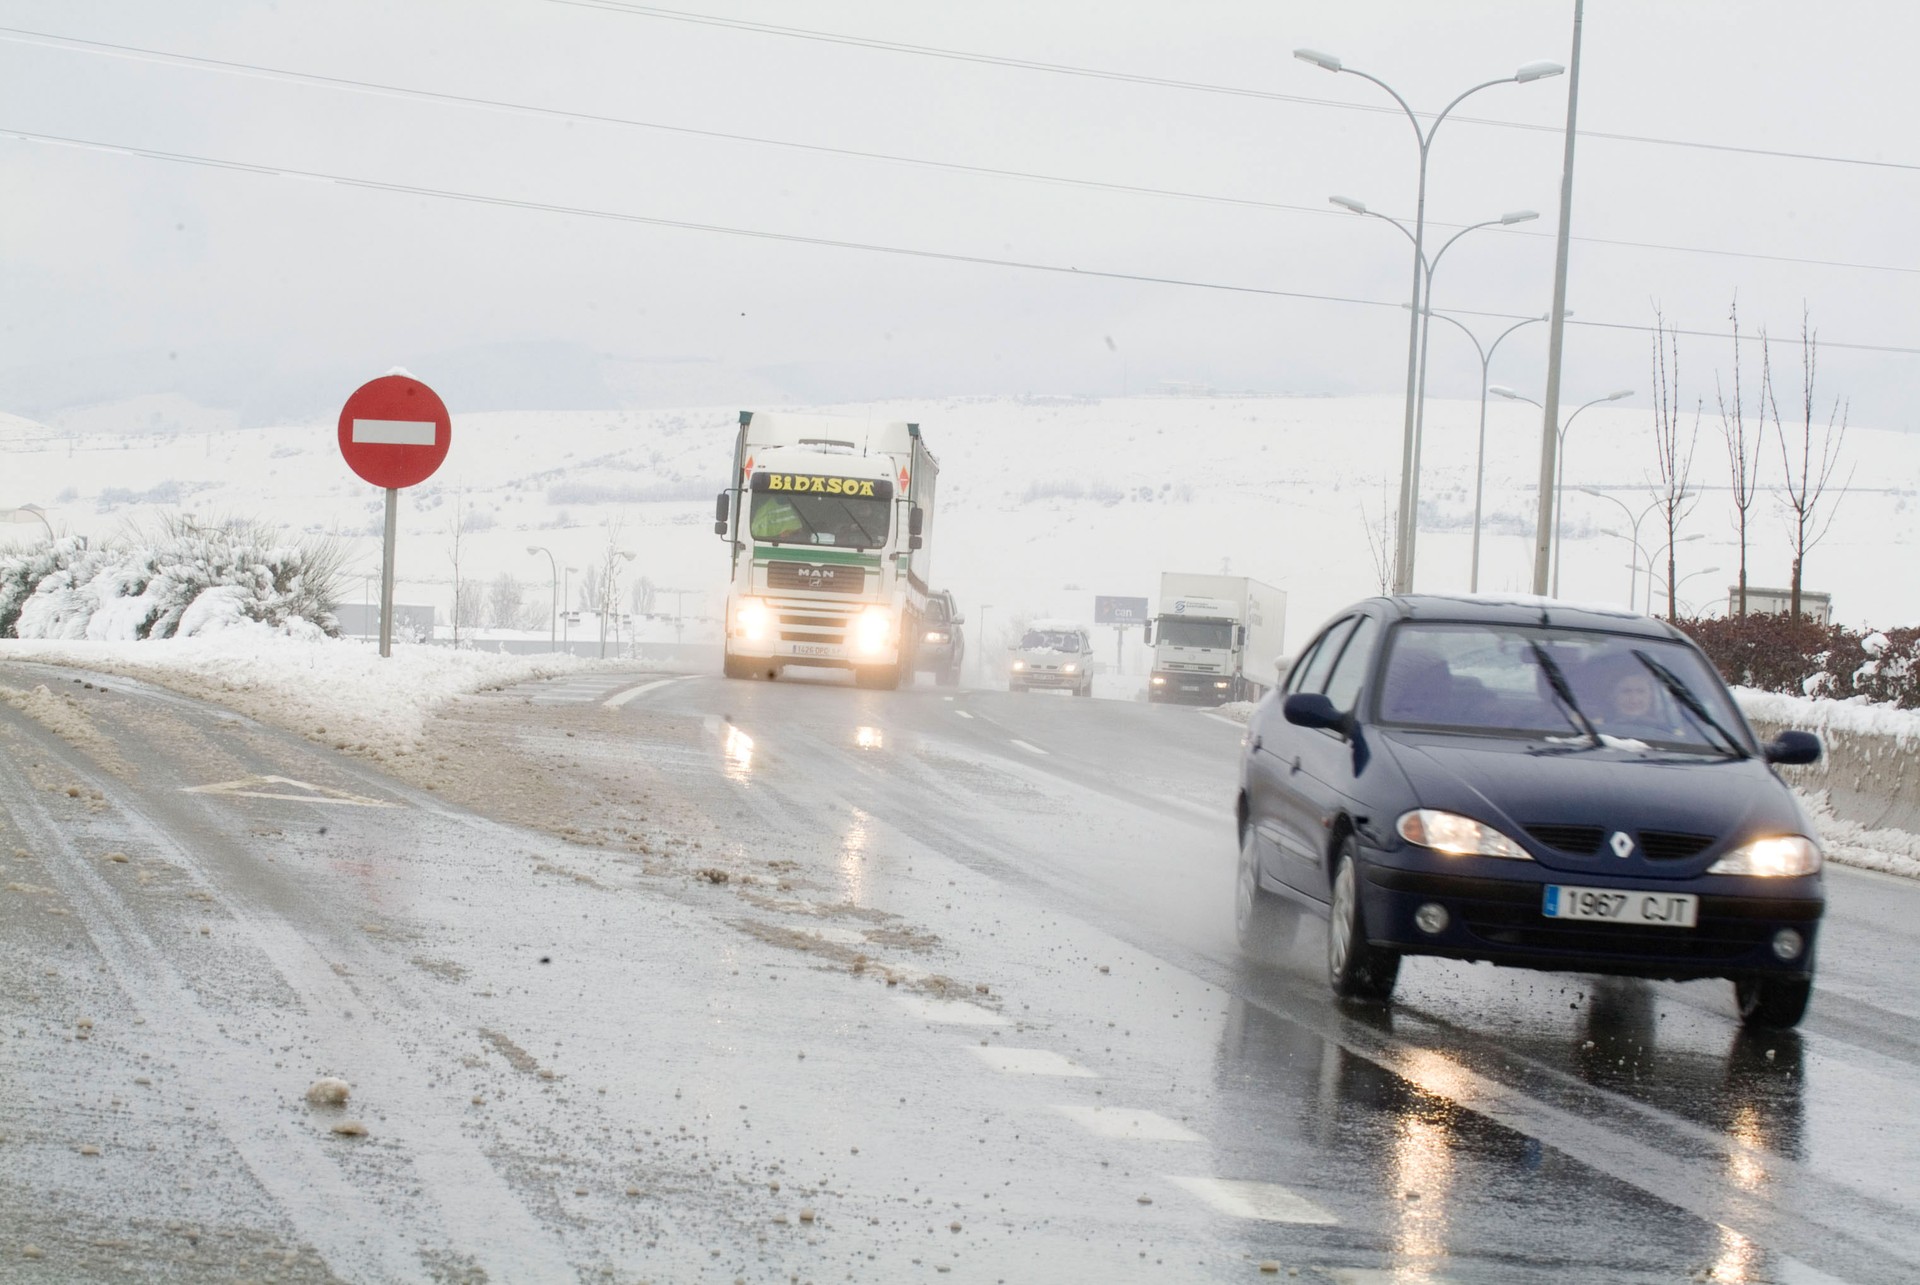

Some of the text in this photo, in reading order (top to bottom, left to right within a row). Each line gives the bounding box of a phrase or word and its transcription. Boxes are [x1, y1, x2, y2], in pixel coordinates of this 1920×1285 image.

[798, 568, 834, 578] MAN
[1114, 608, 1133, 617] can
[1567, 890, 1690, 923] 1967 CJT
